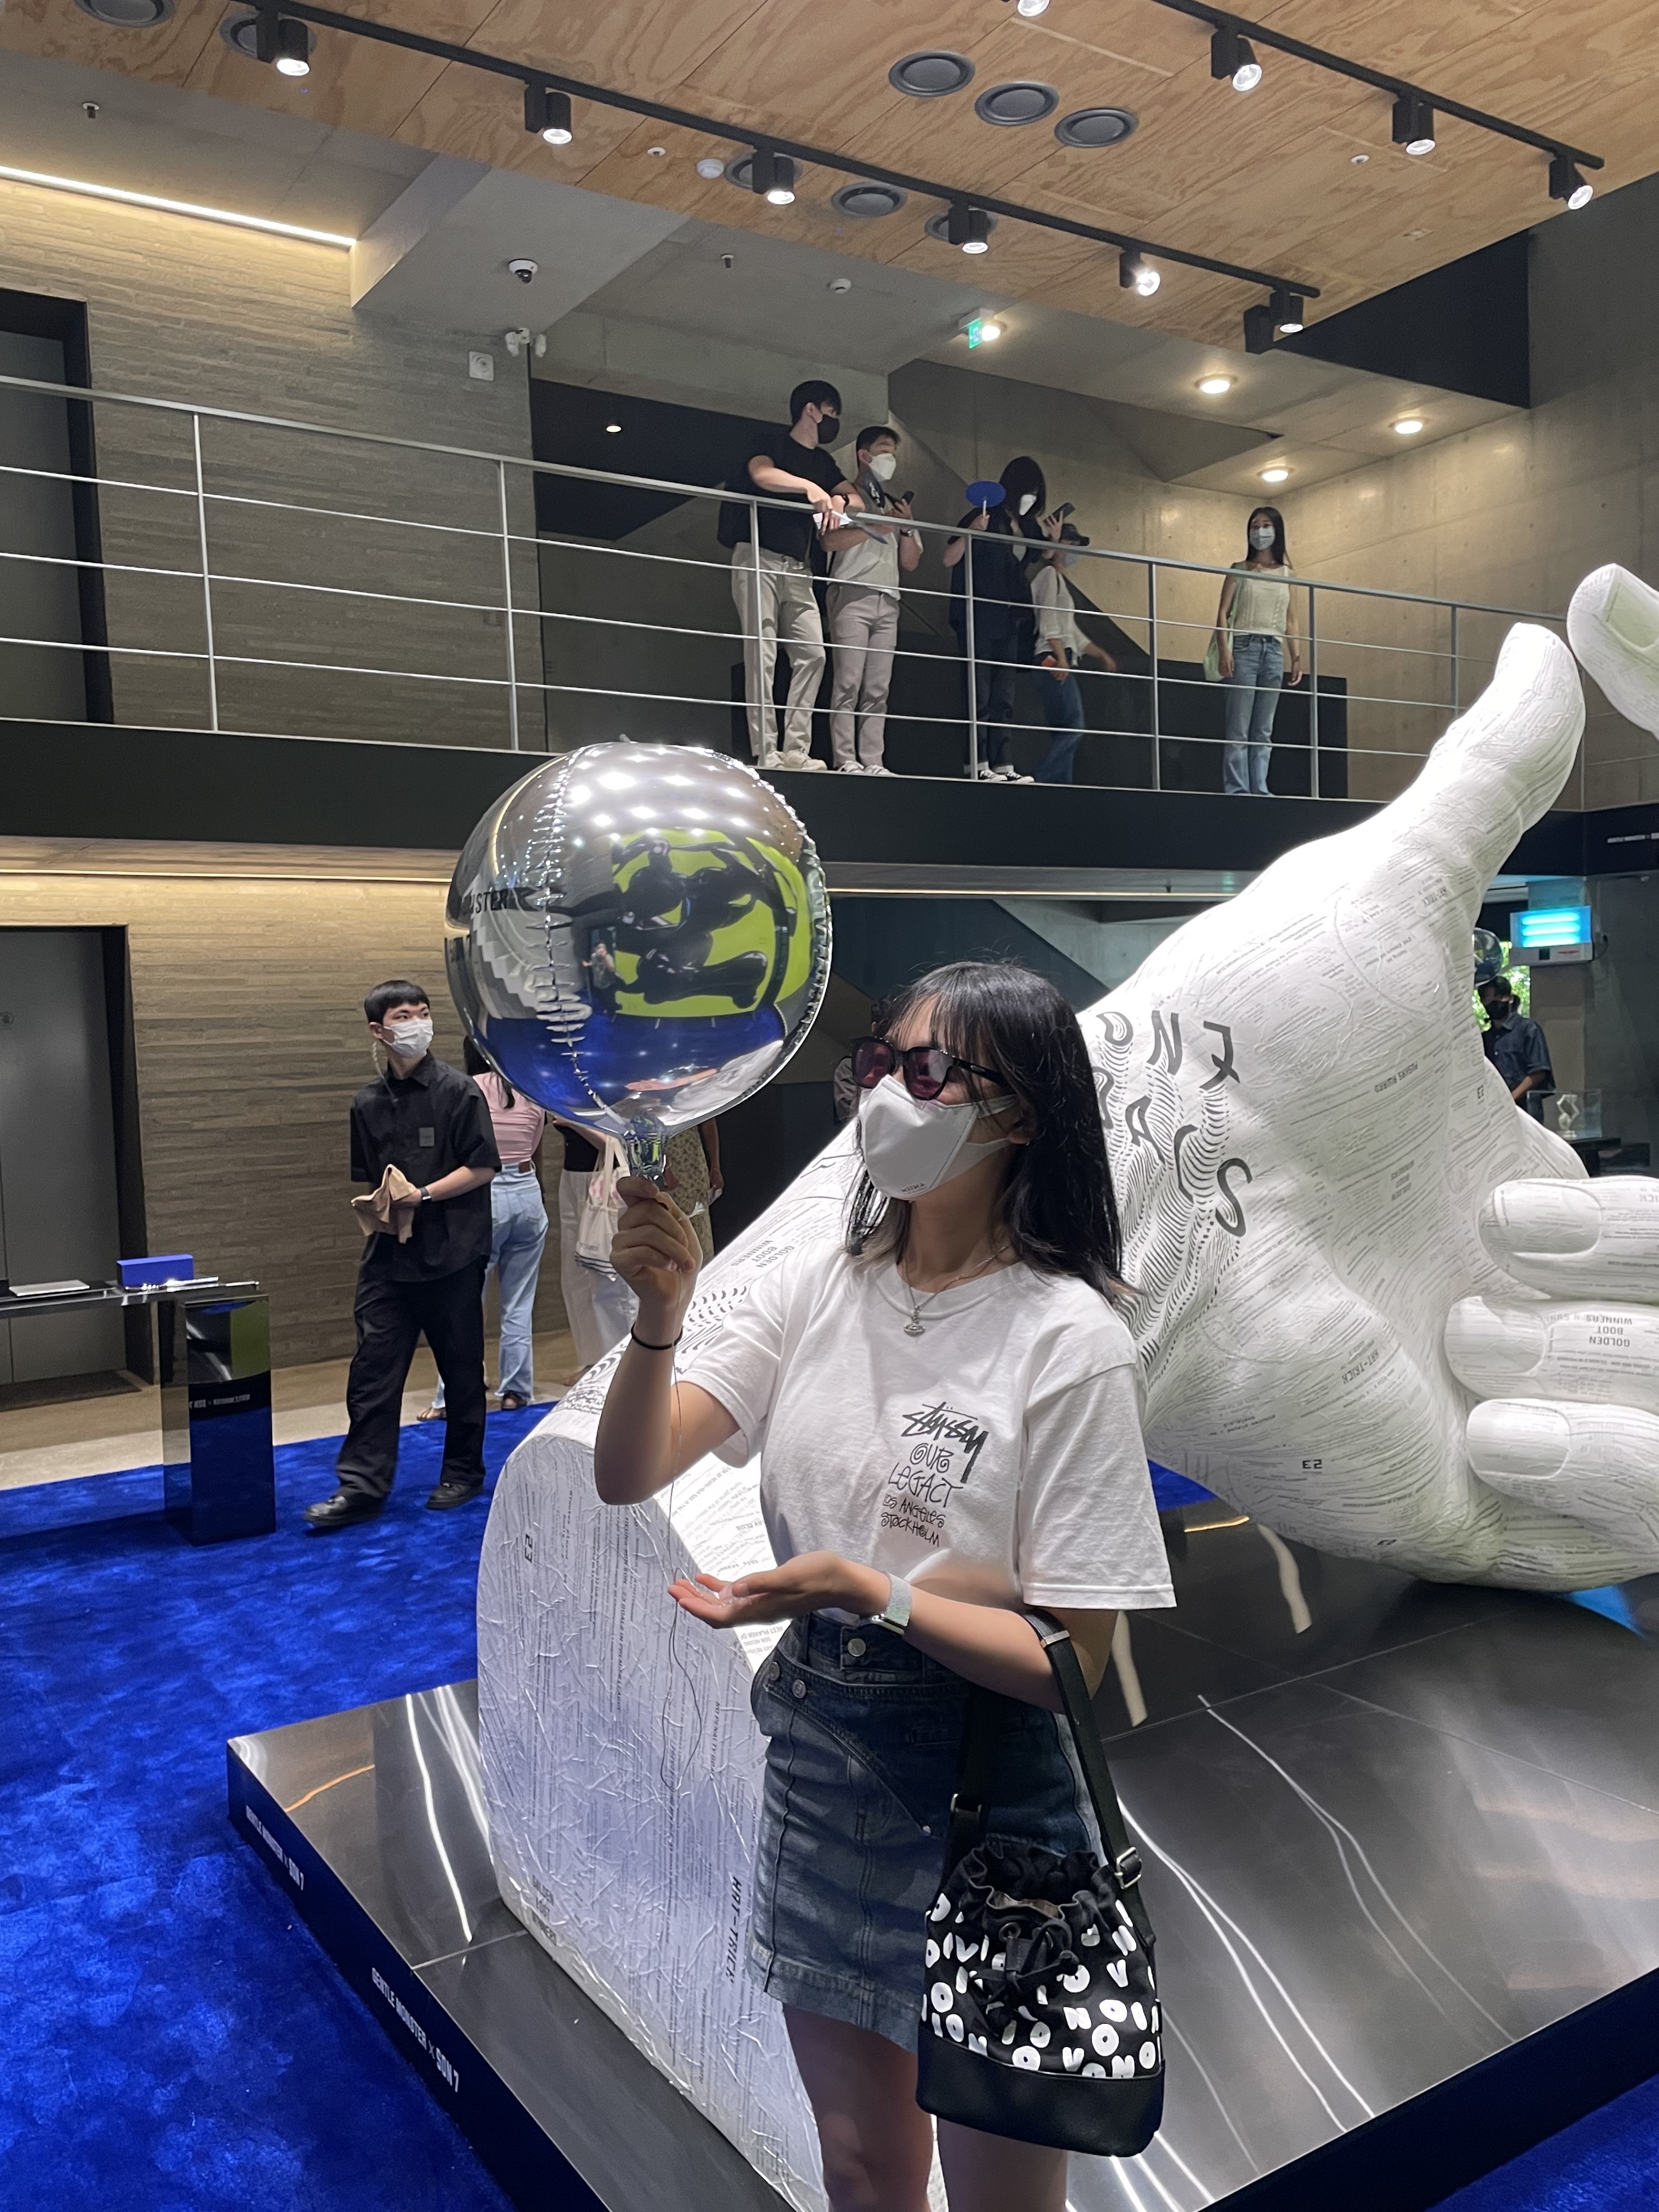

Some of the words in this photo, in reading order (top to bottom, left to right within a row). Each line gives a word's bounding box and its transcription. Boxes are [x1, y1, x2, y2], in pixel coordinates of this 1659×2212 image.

[751, 1246, 777, 1262] BOOT
[755, 1246, 794, 1267] GOLDEN
[1586, 1314, 1632, 1324] WINNERS
[1596, 1326, 1623, 1335] BOOT
[1589, 1336, 1629, 1347] GOLDEN
[725, 1875, 742, 1984] HAT-TRICK
